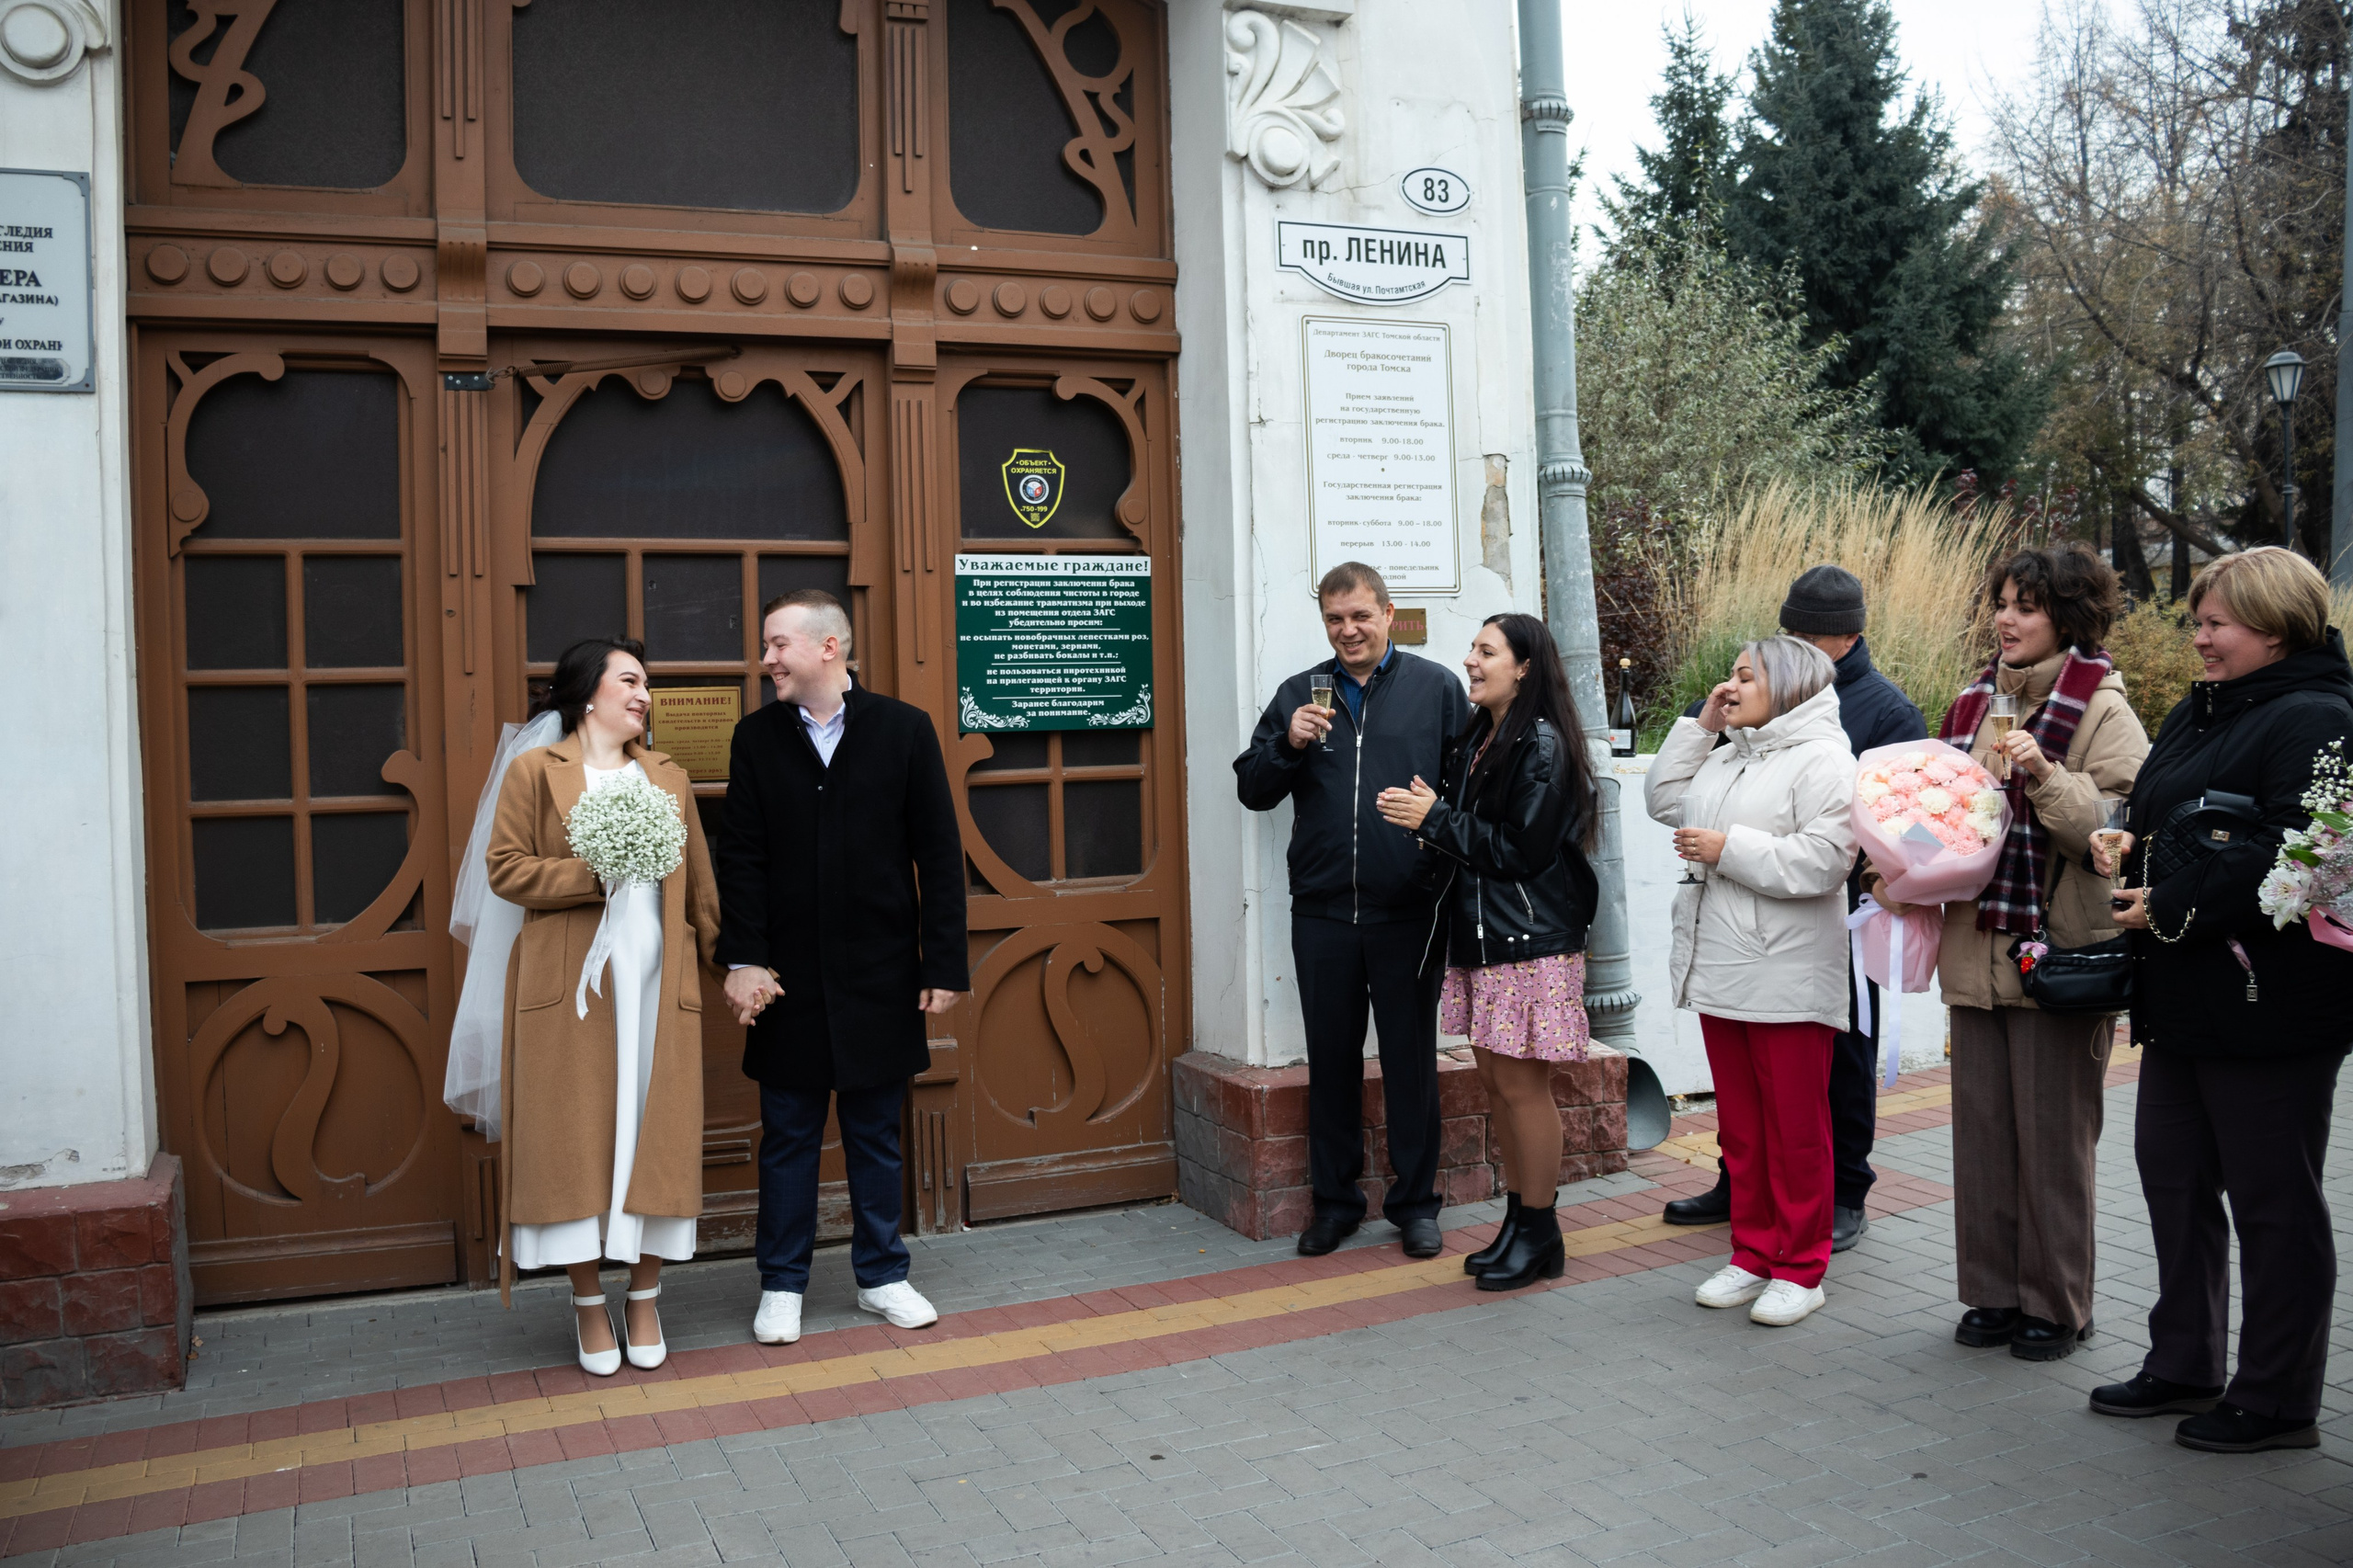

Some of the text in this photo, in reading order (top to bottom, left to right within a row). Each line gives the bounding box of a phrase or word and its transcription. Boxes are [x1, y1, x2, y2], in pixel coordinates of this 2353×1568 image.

[1424, 178, 1449, 203] 83
[0, 241, 34, 253] НИЯ
[1303, 237, 1446, 268] пр. ЛЕНИНА
[1327, 273, 1426, 294] Бывшая ул. Почтамтская
[0, 293, 59, 306] ГАЗИНА)
[1313, 329, 1359, 338] Департамент
[1414, 334, 1440, 342] области
[1324, 350, 1431, 362] Дворец бракосочетаний
[1347, 363, 1411, 372] города Томска
[1352, 406, 1420, 415] государственную
[1420, 420, 1445, 428] брака.
[1358, 453, 1388, 461] четверг
[1324, 481, 1391, 490] Государственная
[1396, 494, 1422, 502] брака:
[959, 559, 1148, 574] Уважаемые граждане!
[994, 580, 1051, 588] регистрации
[1109, 579, 1134, 587] брака
[1006, 589, 1061, 597] соблюдения
[1009, 619, 1065, 628] убедительно
[1392, 620, 1424, 631] РИТЬ
[1015, 633, 1075, 642] новобрачных
[1008, 652, 1054, 661] разбивать
[1063, 666, 1126, 675] пиротехникой
[1000, 676, 1063, 686] прилегающей
[1073, 676, 1102, 685] органу
[1030, 686, 1086, 694] территории.
[661, 697, 731, 706] ВНИМАНИЕ!
[1012, 699, 1104, 709] Заранее благодарим
